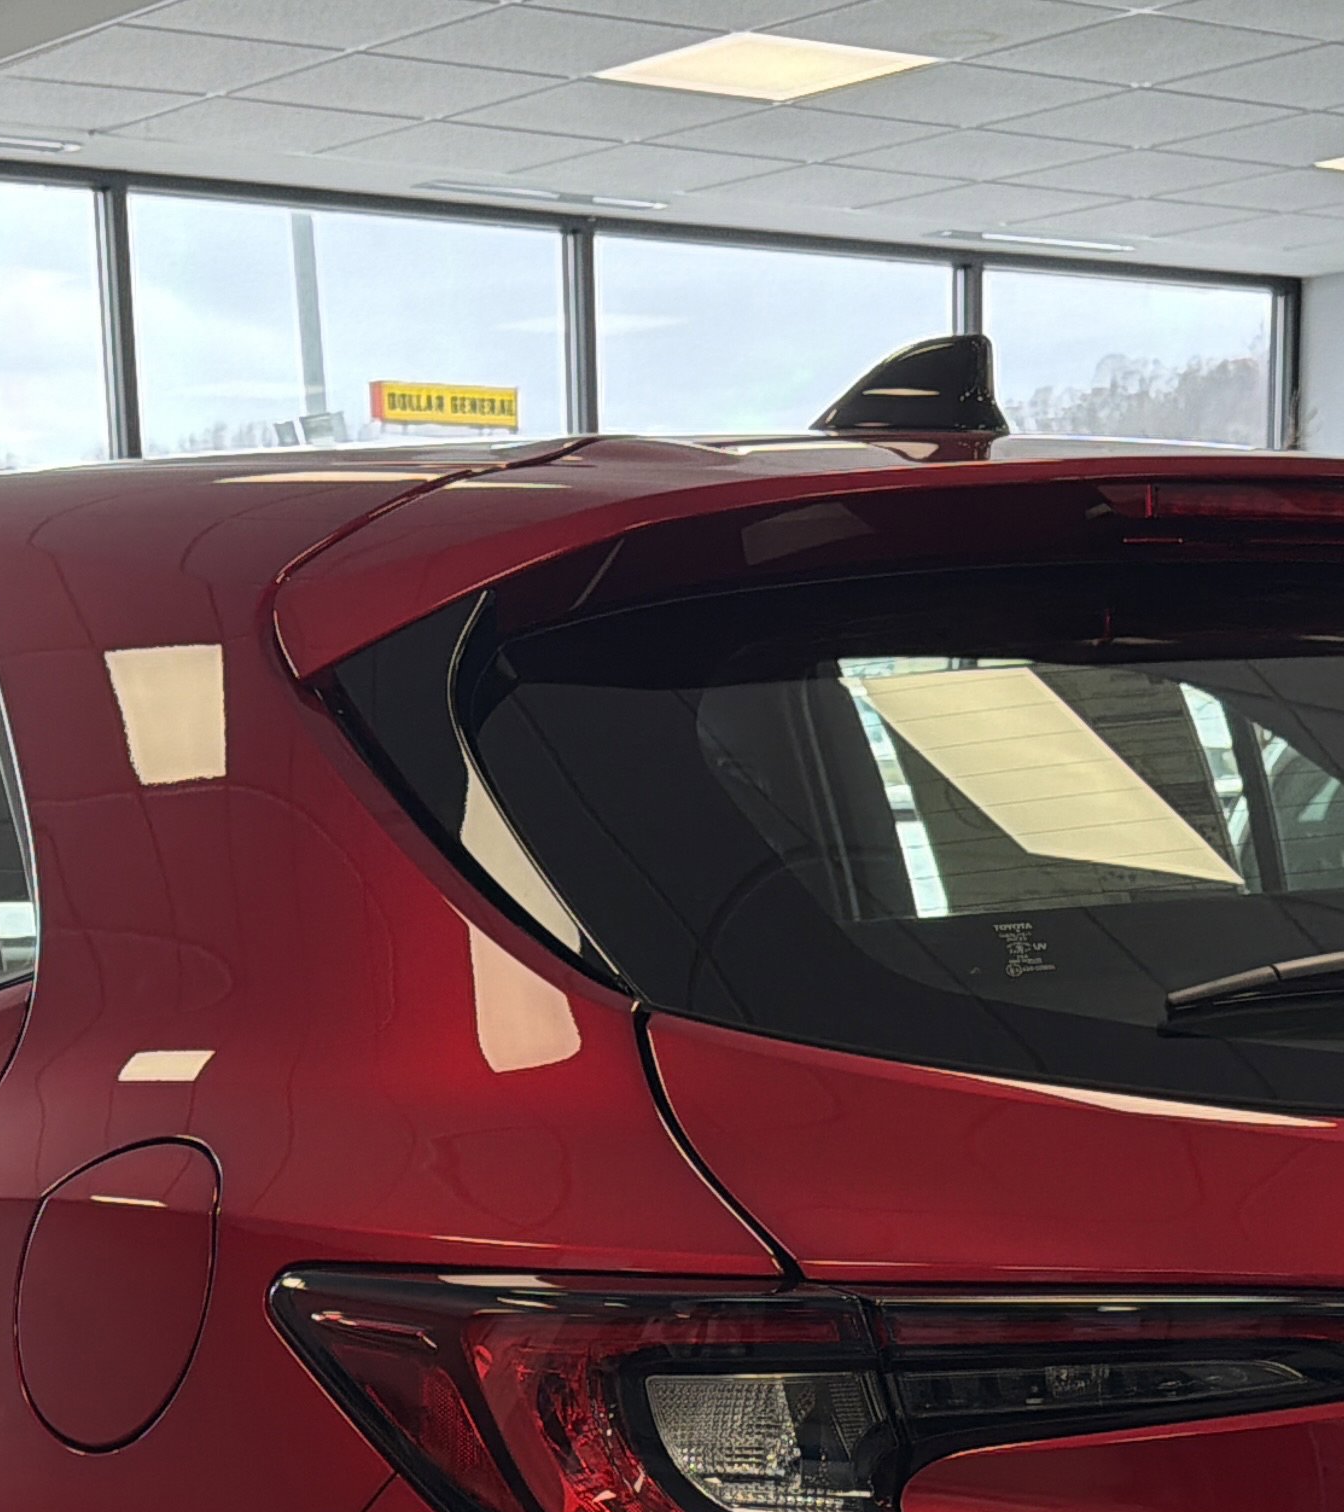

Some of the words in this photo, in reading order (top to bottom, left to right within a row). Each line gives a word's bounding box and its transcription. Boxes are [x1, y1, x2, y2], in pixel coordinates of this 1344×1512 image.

[387, 392, 445, 413] DOLLAR
[450, 396, 514, 416] GENERAL
[993, 922, 1033, 932] TOYOTA
